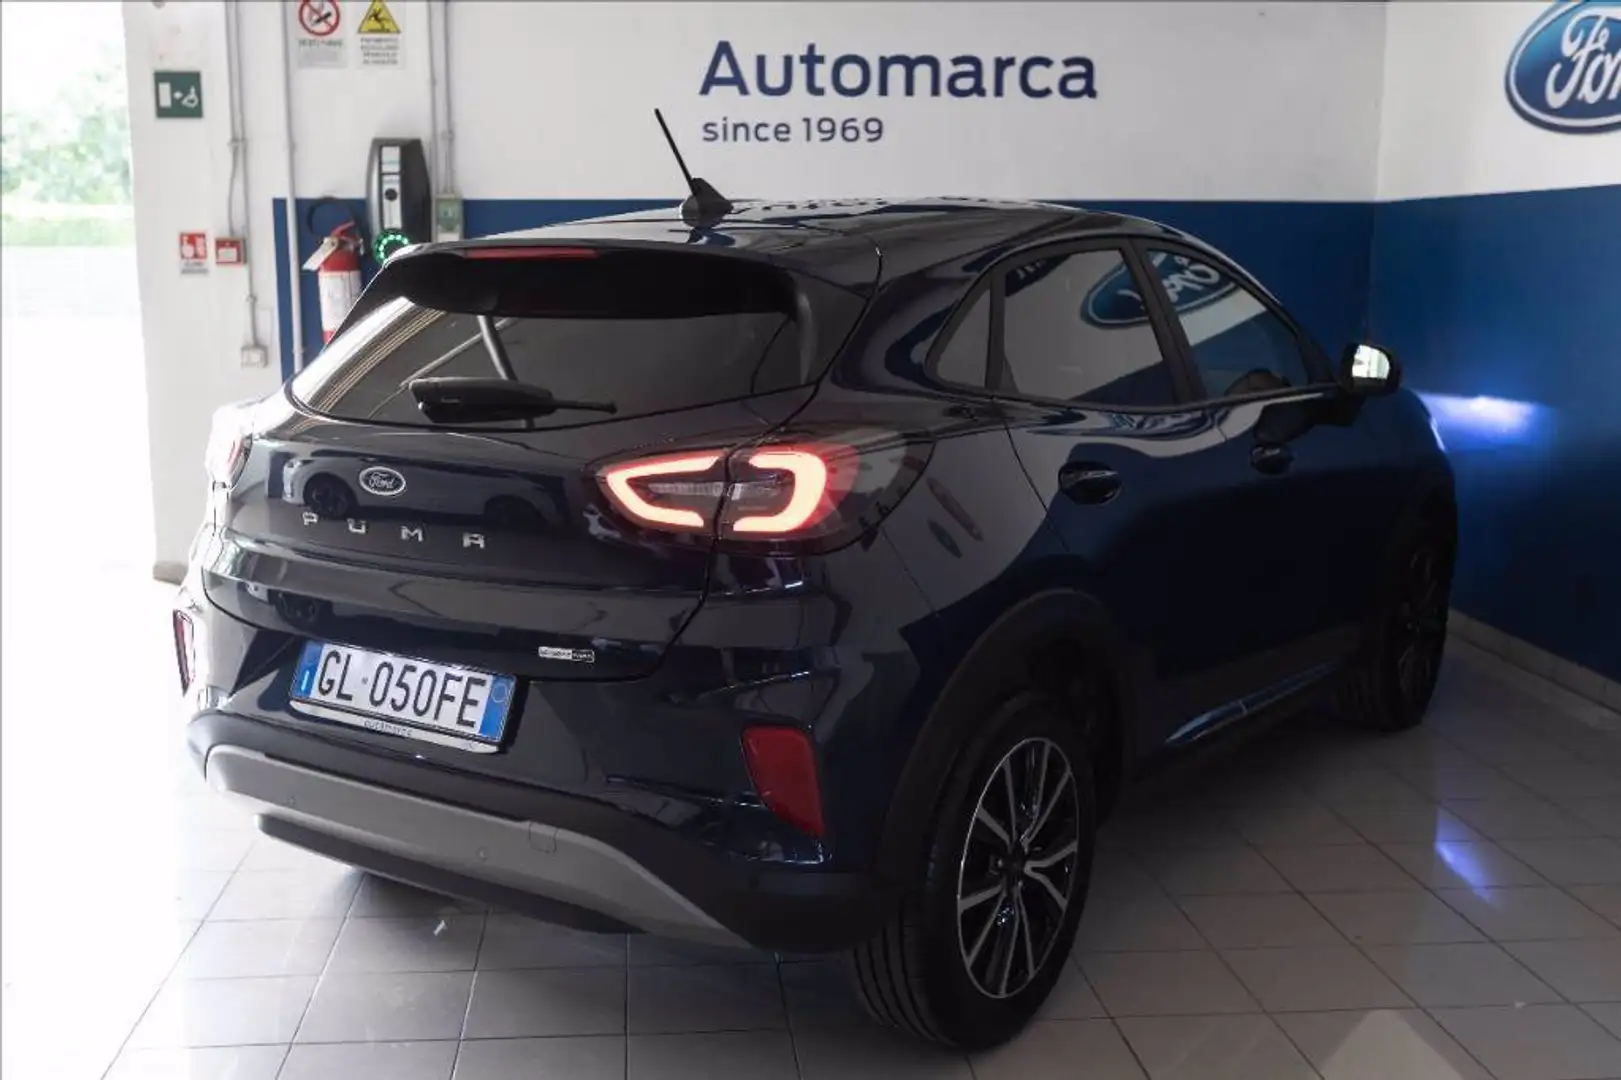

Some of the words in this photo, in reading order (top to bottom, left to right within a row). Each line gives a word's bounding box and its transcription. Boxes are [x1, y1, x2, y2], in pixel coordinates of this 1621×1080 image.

[699, 40, 1098, 99] Automarca
[702, 117, 791, 143] since
[802, 117, 884, 143] 1969
[368, 472, 396, 489] Ford
[302, 511, 486, 549] PUMA
